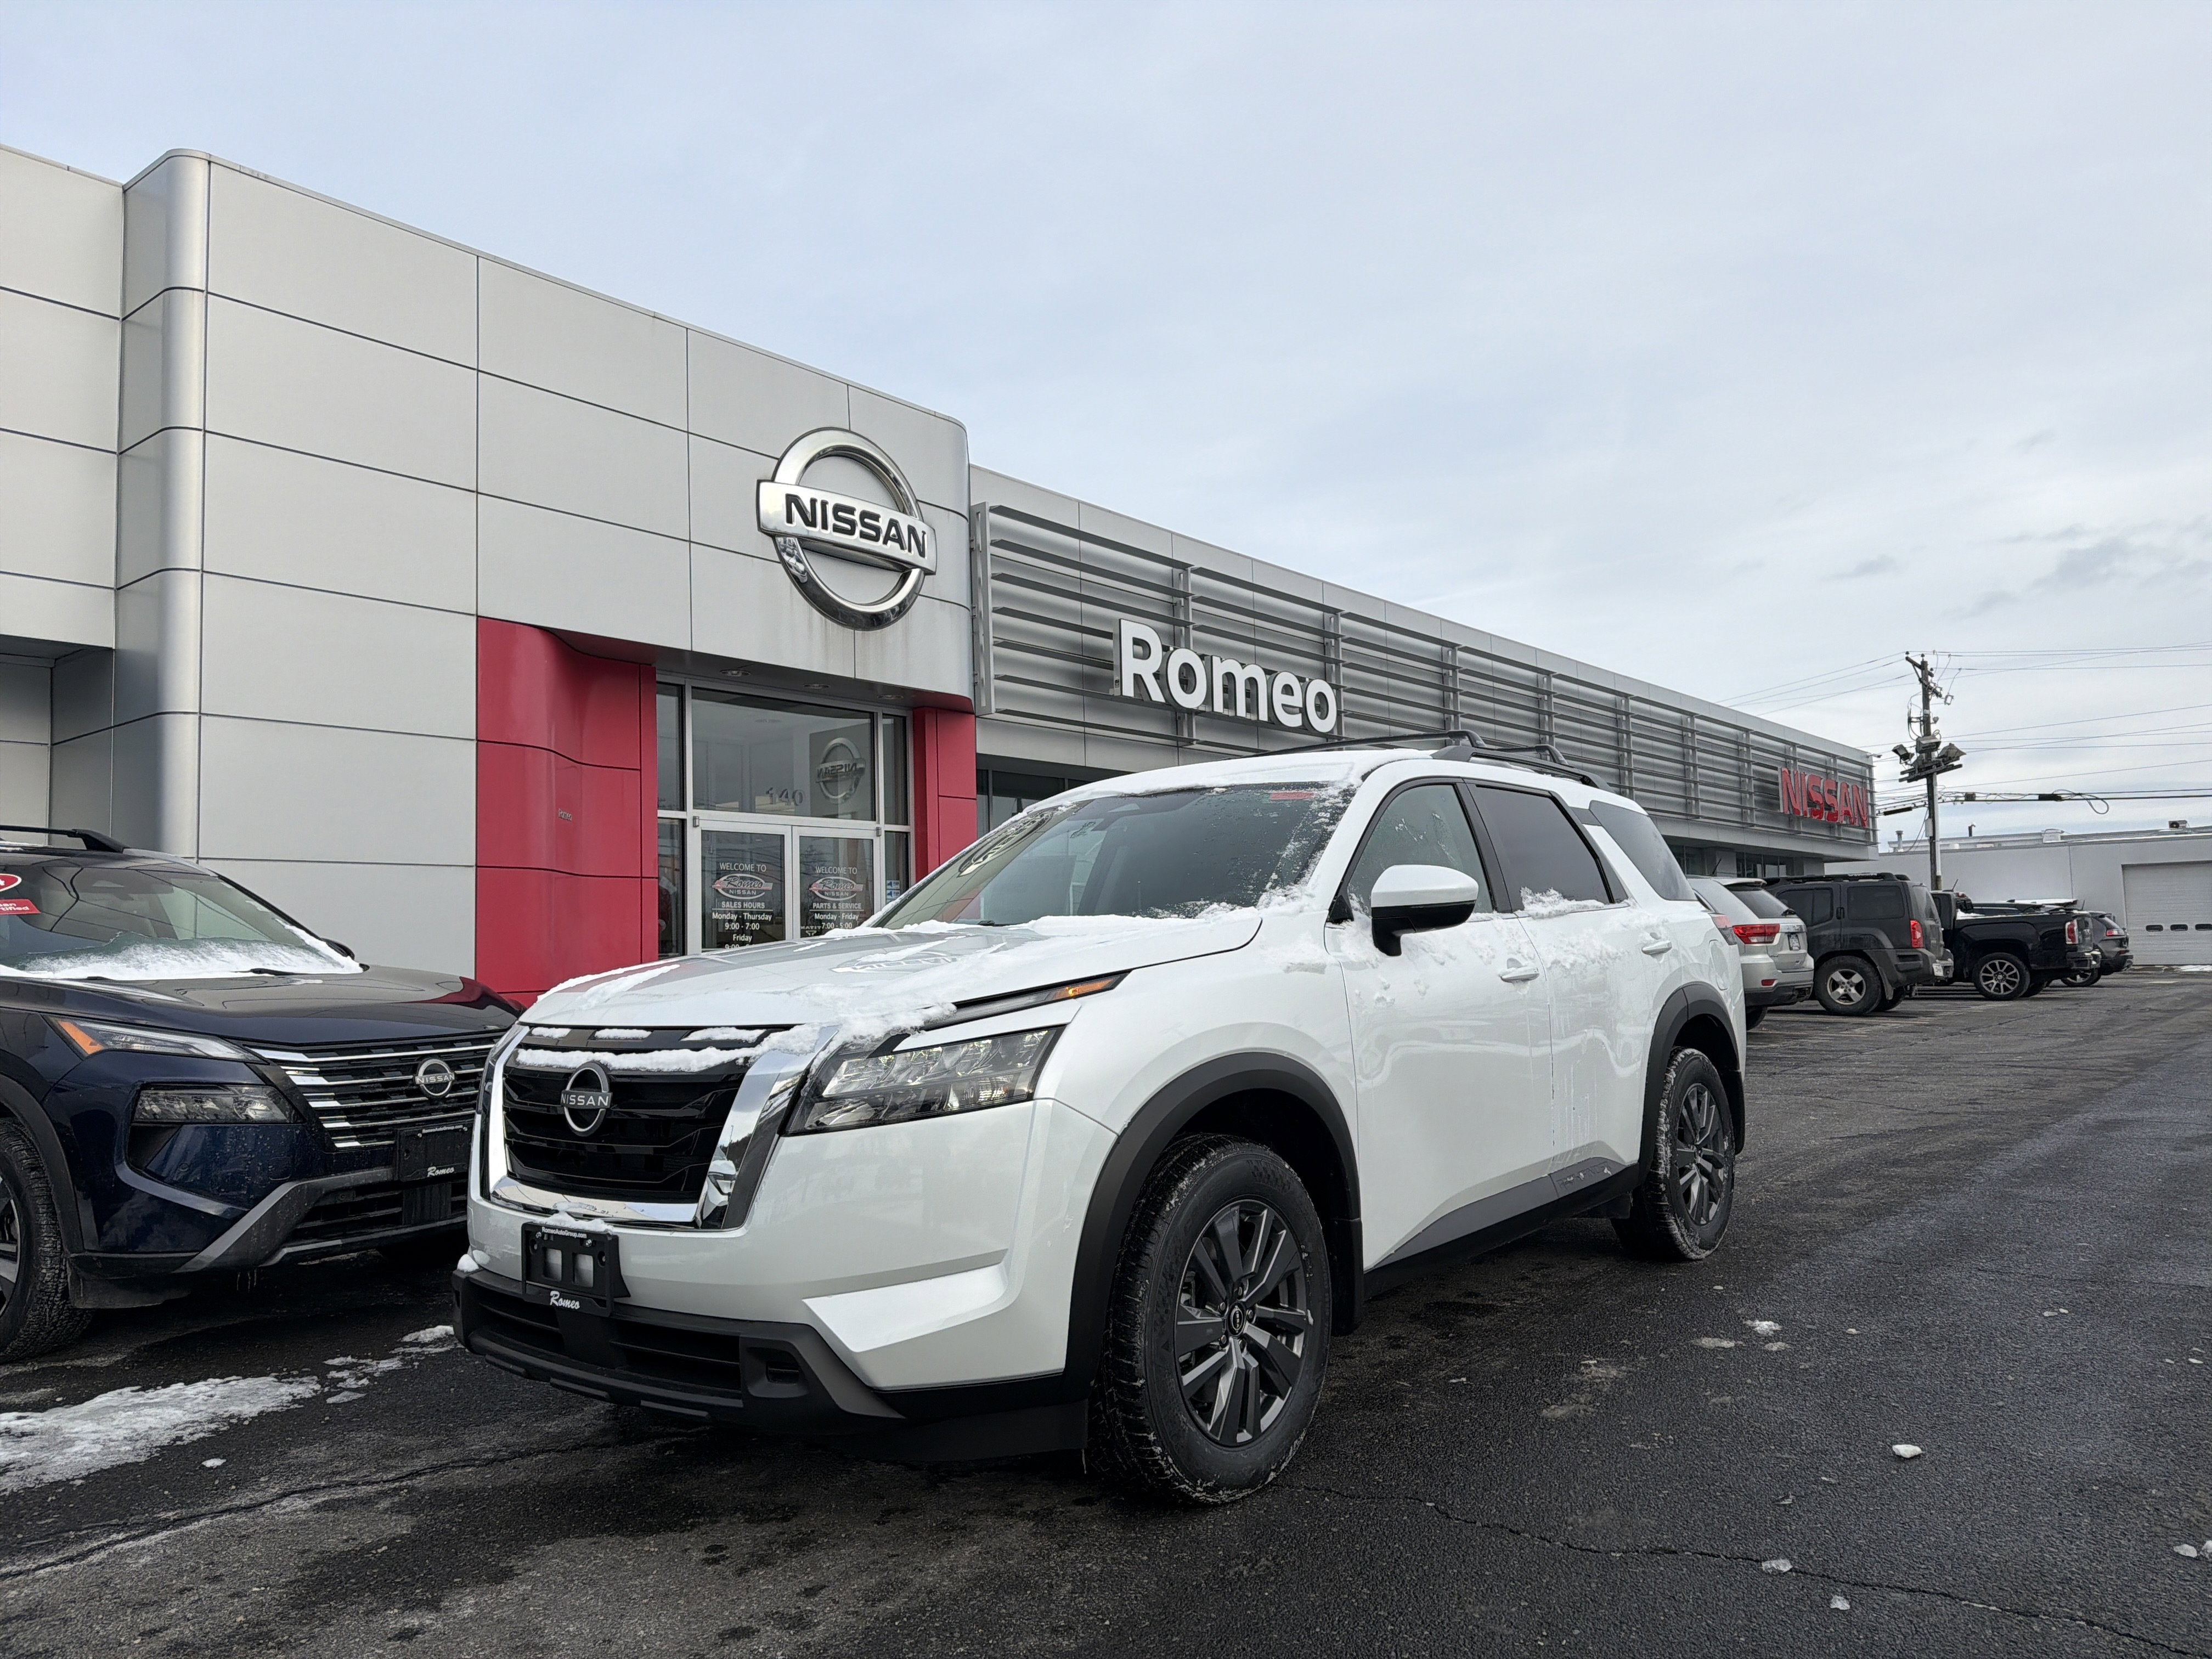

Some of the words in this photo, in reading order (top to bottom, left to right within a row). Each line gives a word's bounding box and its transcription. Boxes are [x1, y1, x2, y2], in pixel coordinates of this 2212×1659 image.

[785, 493, 927, 558] NISSAN
[1118, 618, 1338, 733] Romeo
[766, 787, 804, 806] 140
[1781, 767, 1869, 828] NISSAN
[720, 862, 755, 872] WELCOME
[724, 875, 763, 888] Romeo
[821, 878, 855, 890] Romeo
[712, 912, 737, 921] Monday
[743, 912, 772, 921] Thursday
[814, 912, 837, 921] Monday
[733, 934, 753, 943] Friday
[416, 1073, 455, 1084] NISSAN
[561, 1093, 609, 1106] NISSAN
[427, 1166, 455, 1178] Romeo
[541, 1226, 587, 1239] RomeoAutoGroup.com
[550, 1290, 580, 1310] Romeo
